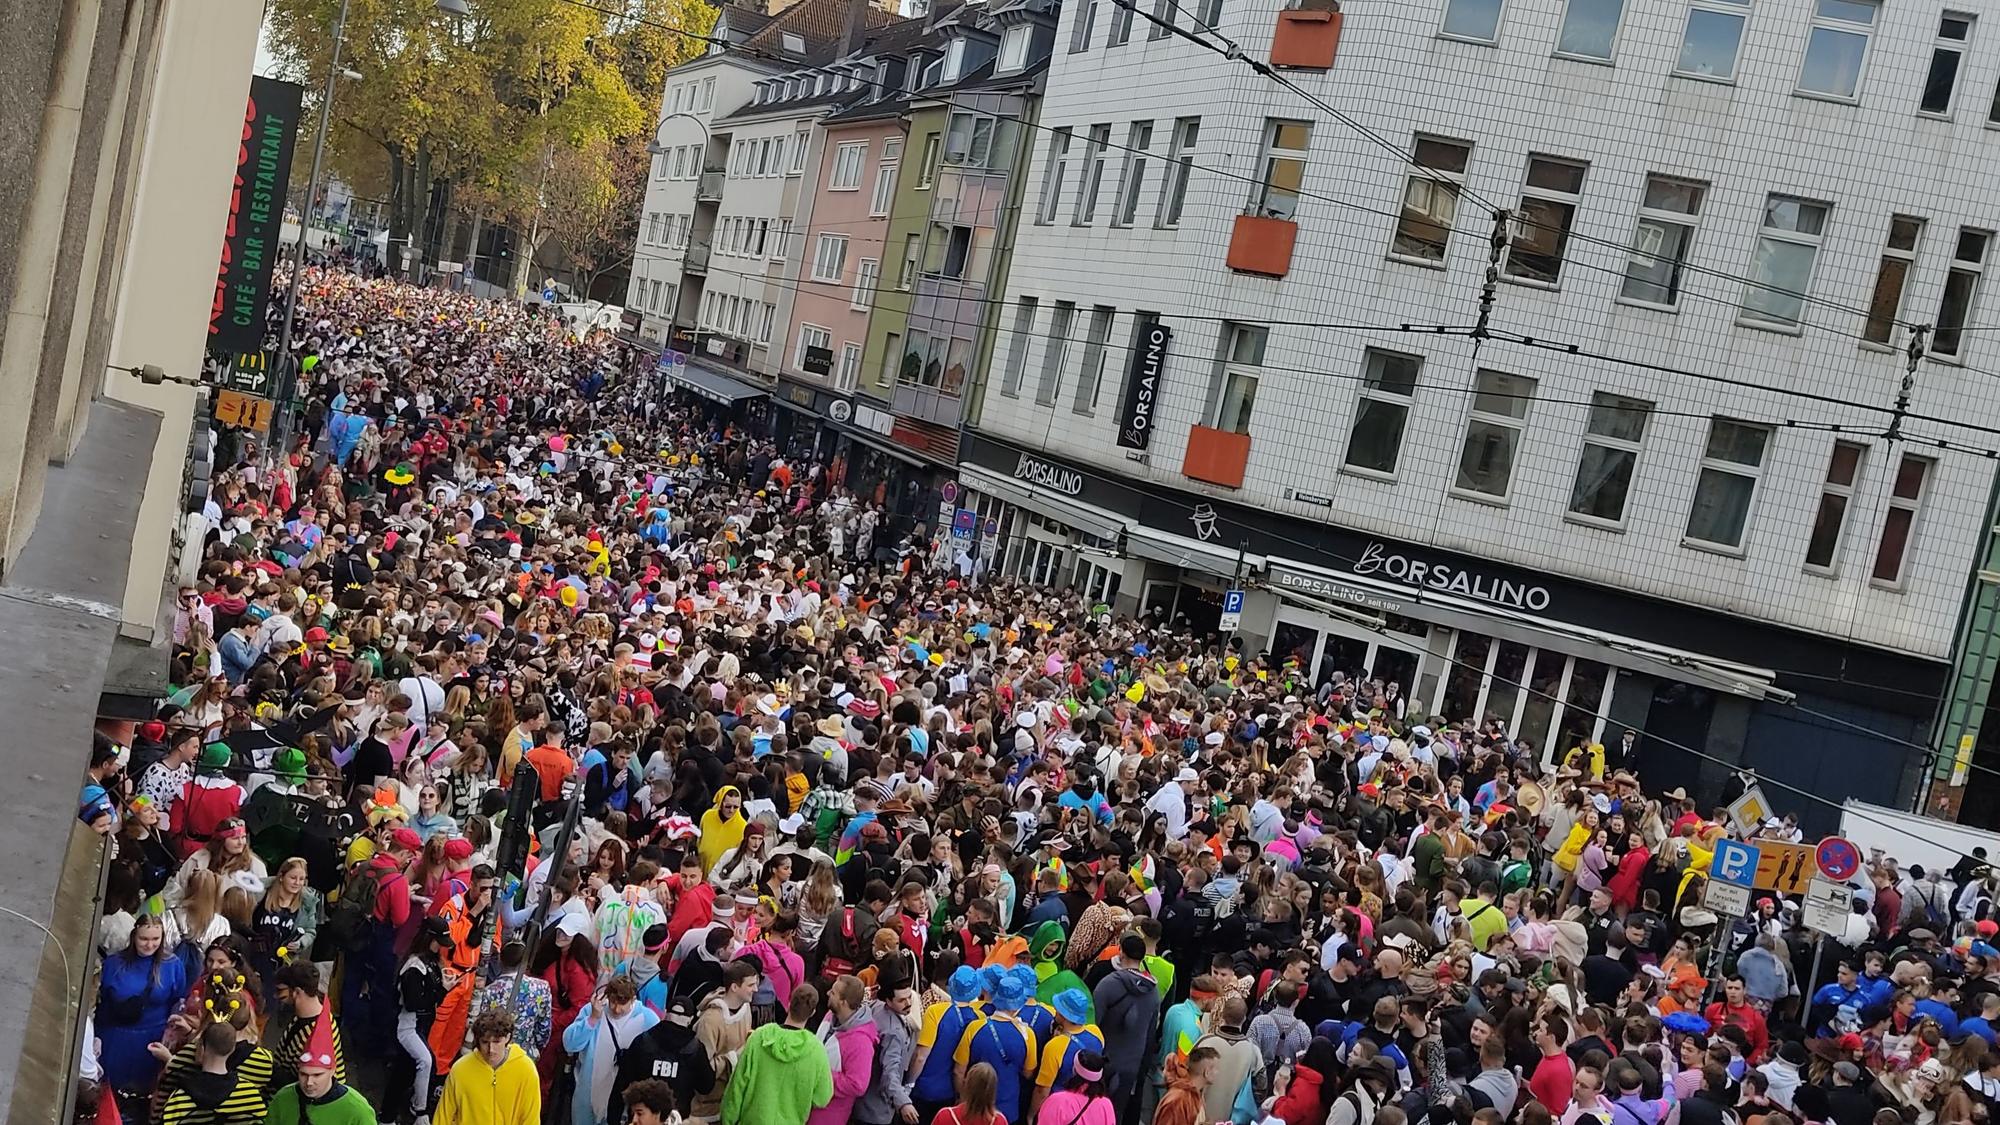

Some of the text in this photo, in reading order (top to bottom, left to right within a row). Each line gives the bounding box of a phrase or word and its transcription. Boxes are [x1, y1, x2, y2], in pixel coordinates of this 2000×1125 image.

[233, 114, 284, 326] CAFÉ BAR RESTAURANT
[1124, 330, 1164, 446] BORSALINO
[1014, 453, 1082, 495] BORSALINO
[1282, 574, 1366, 602] BORSALINO
[1353, 540, 1550, 610] BORSALINO
[1722, 845, 1749, 875] P
[652, 1059, 679, 1078] FBI
